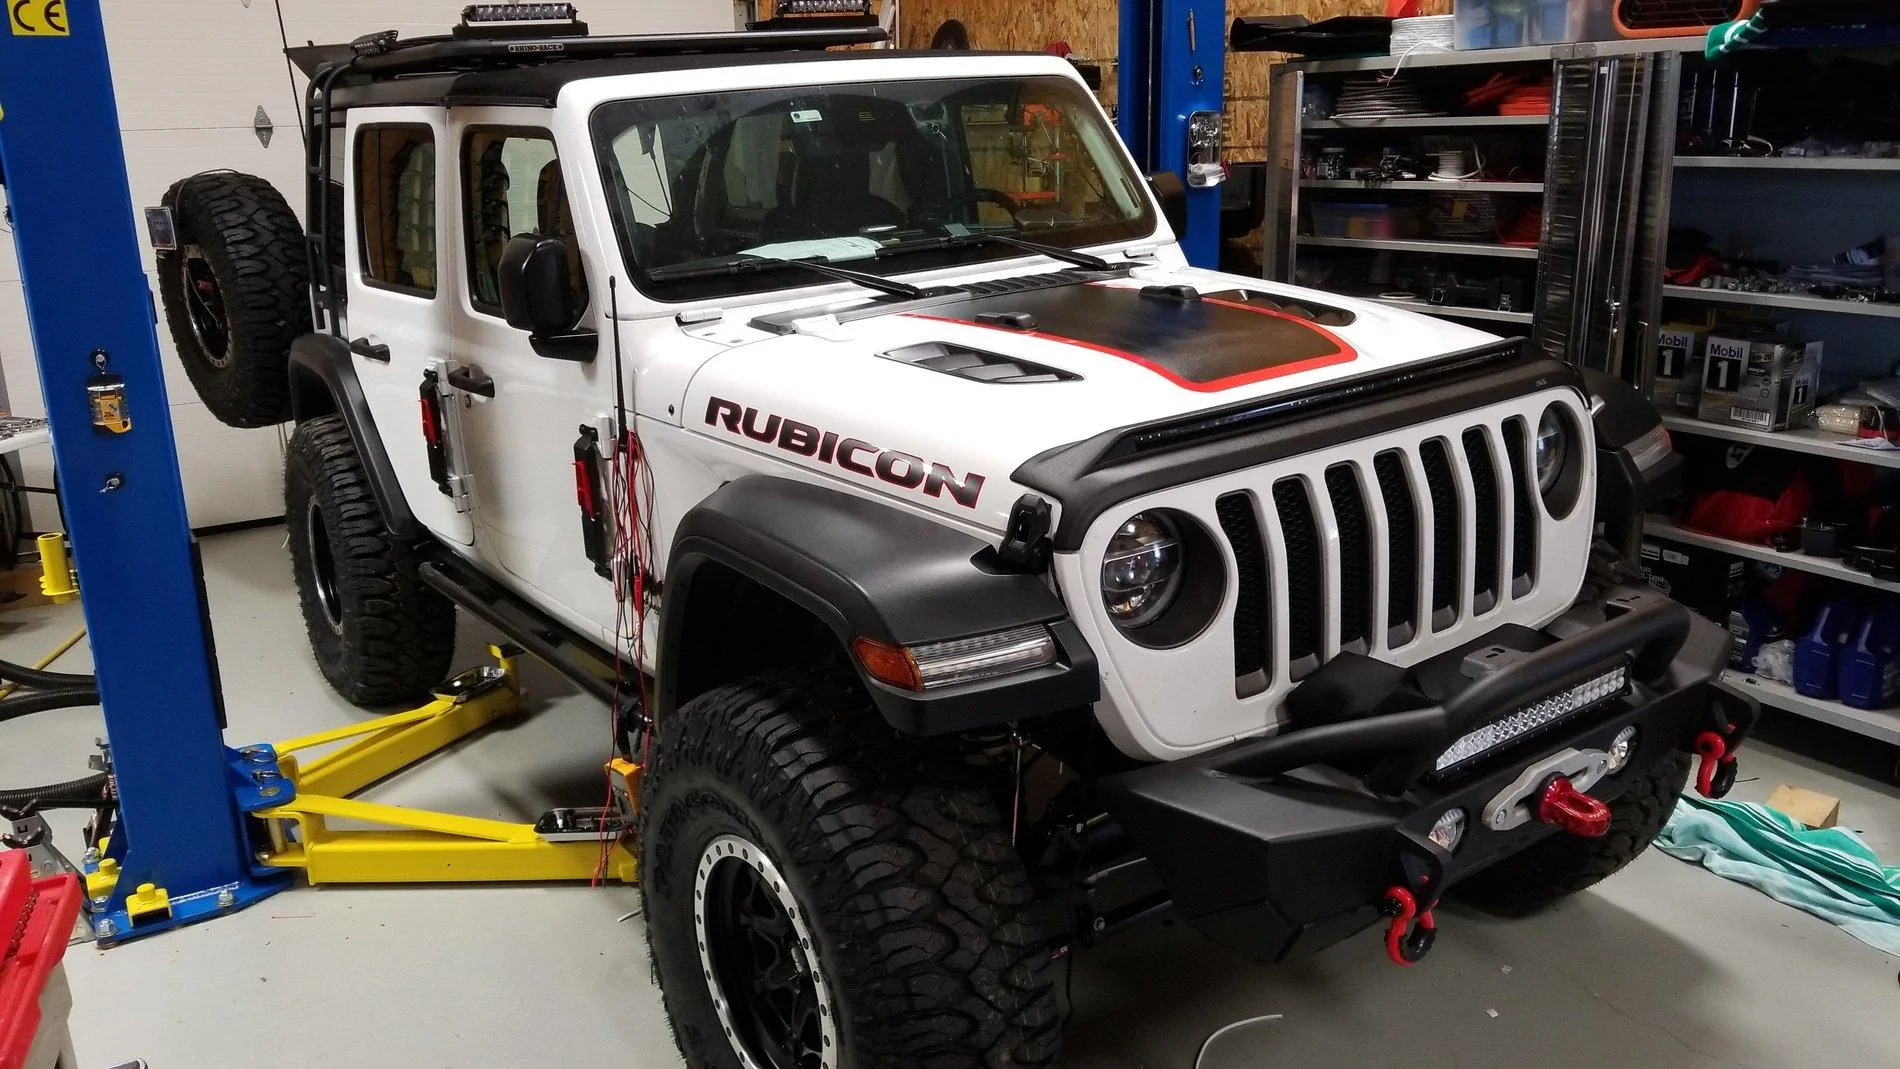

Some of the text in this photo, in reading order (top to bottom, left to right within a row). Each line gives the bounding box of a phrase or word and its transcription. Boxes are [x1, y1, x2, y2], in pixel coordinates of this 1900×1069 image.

[13, 0, 66, 32] CE
[1663, 349, 1673, 376] 1
[1710, 343, 1744, 359] Mobil
[1718, 361, 1728, 388] 1
[705, 396, 985, 509] RUBICON
